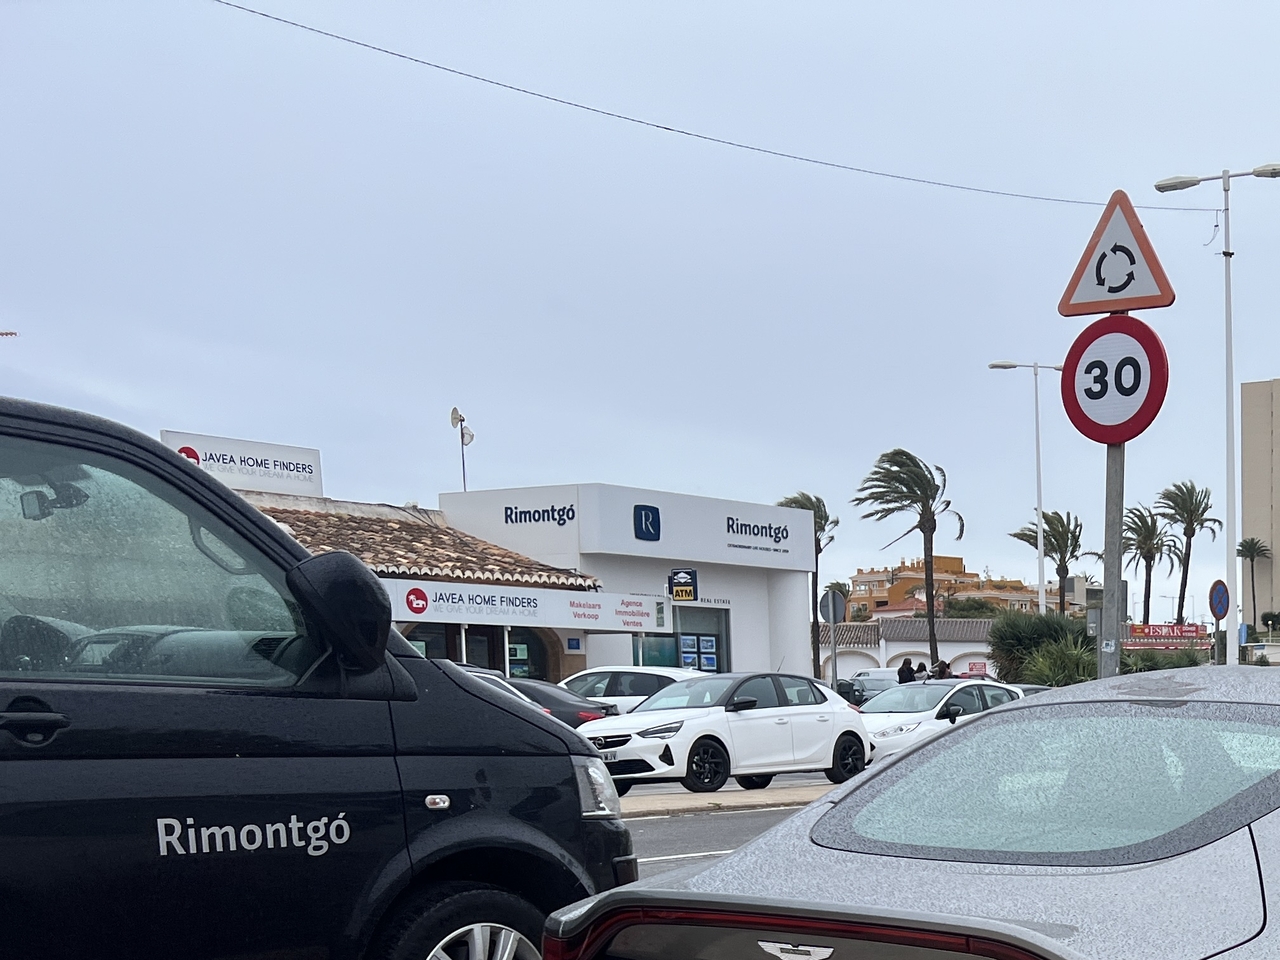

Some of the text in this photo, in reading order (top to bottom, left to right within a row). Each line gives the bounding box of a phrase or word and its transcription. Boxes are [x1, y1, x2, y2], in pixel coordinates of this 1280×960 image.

[1084, 356, 1141, 400] 30
[202, 452, 313, 474] JAVEA HOME FINDERS
[217, 464, 235, 474] GIVE
[237, 466, 257, 476] YOUR
[259, 469, 284, 479] DREAM
[294, 474, 314, 483] HOME
[504, 504, 575, 526] Rimontgó
[727, 516, 789, 543] Rimontgó
[432, 592, 538, 608] JAVEA HOME FINDERS
[674, 590, 693, 598] ATM
[433, 604, 538, 617] WE GIVE YOUR DREAM A HOME
[569, 600, 601, 610] Makelaars
[620, 599, 643, 608] Agence
[572, 611, 600, 621] Verkoop
[622, 619, 643, 627] Ventes
[157, 812, 350, 856] Rimontgó
